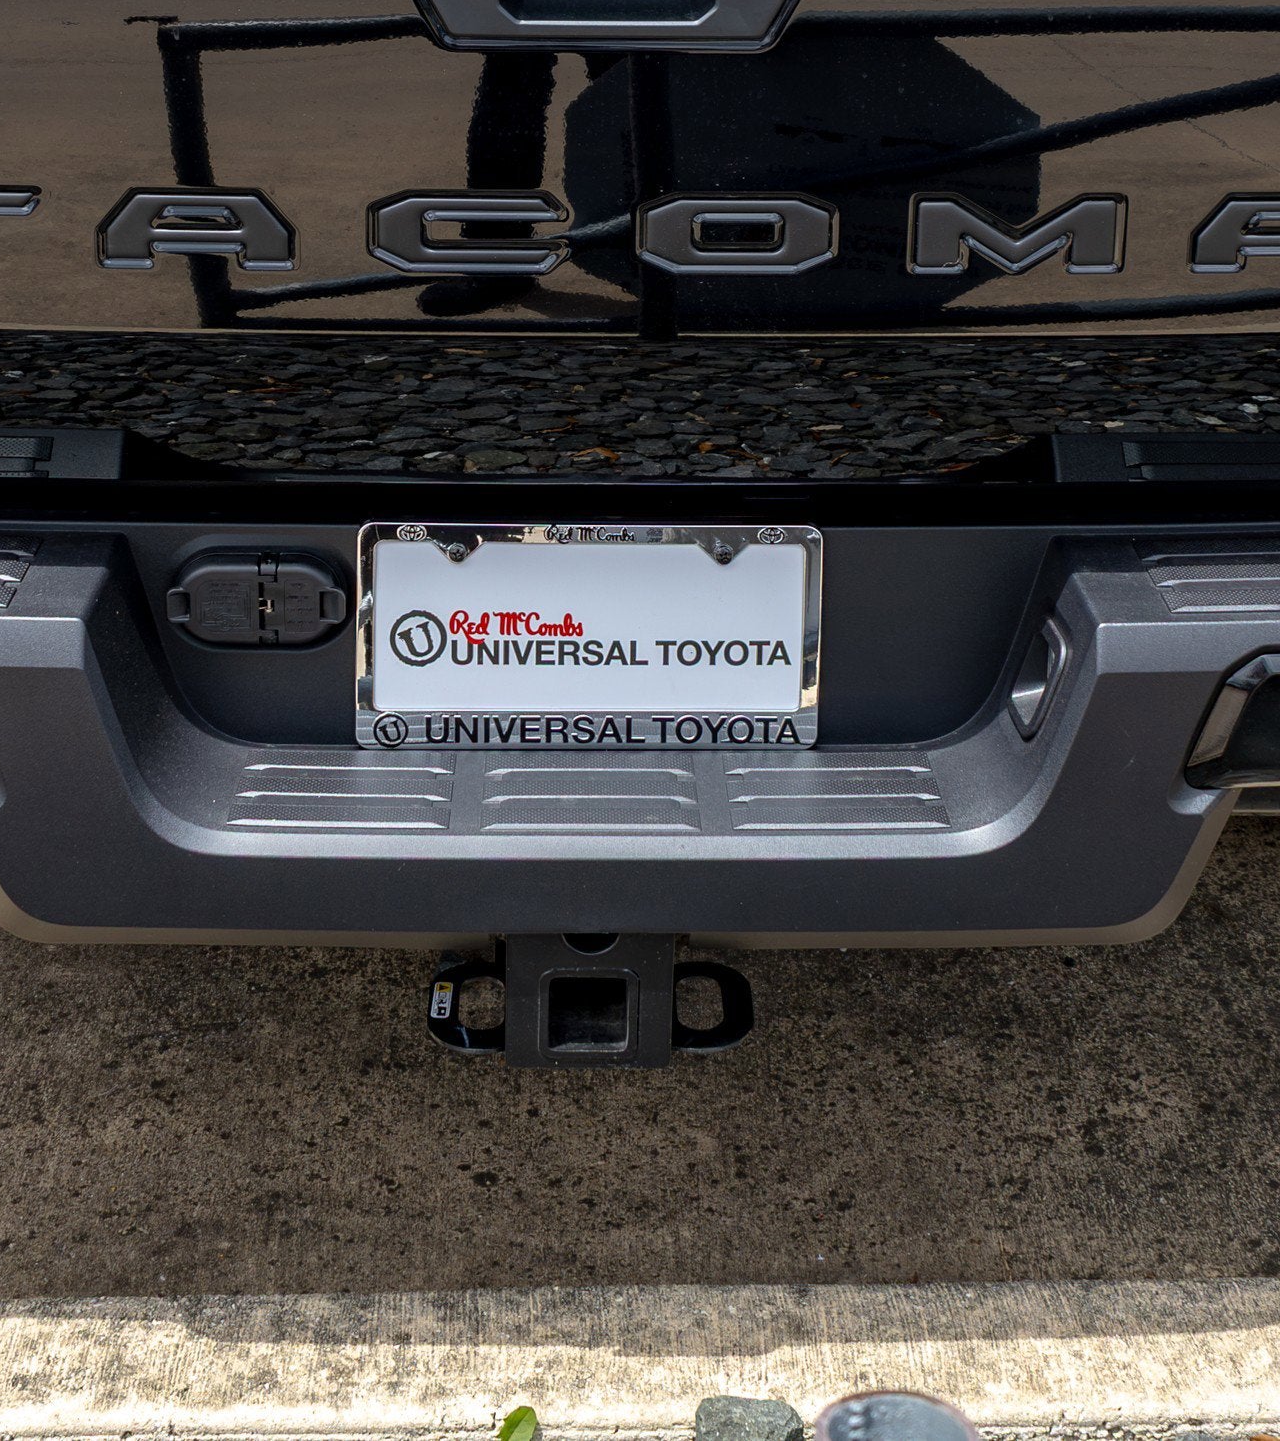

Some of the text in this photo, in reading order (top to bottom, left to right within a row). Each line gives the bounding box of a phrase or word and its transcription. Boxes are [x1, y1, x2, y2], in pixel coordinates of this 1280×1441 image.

[544, 525, 573, 544] Red
[577, 526, 635, 543] McCombs
[449, 610, 584, 646] Red McCombs
[451, 639, 792, 667] UNIVERSAL TOYOTA
[425, 714, 802, 745] UNIVERSAL TOYOTA
